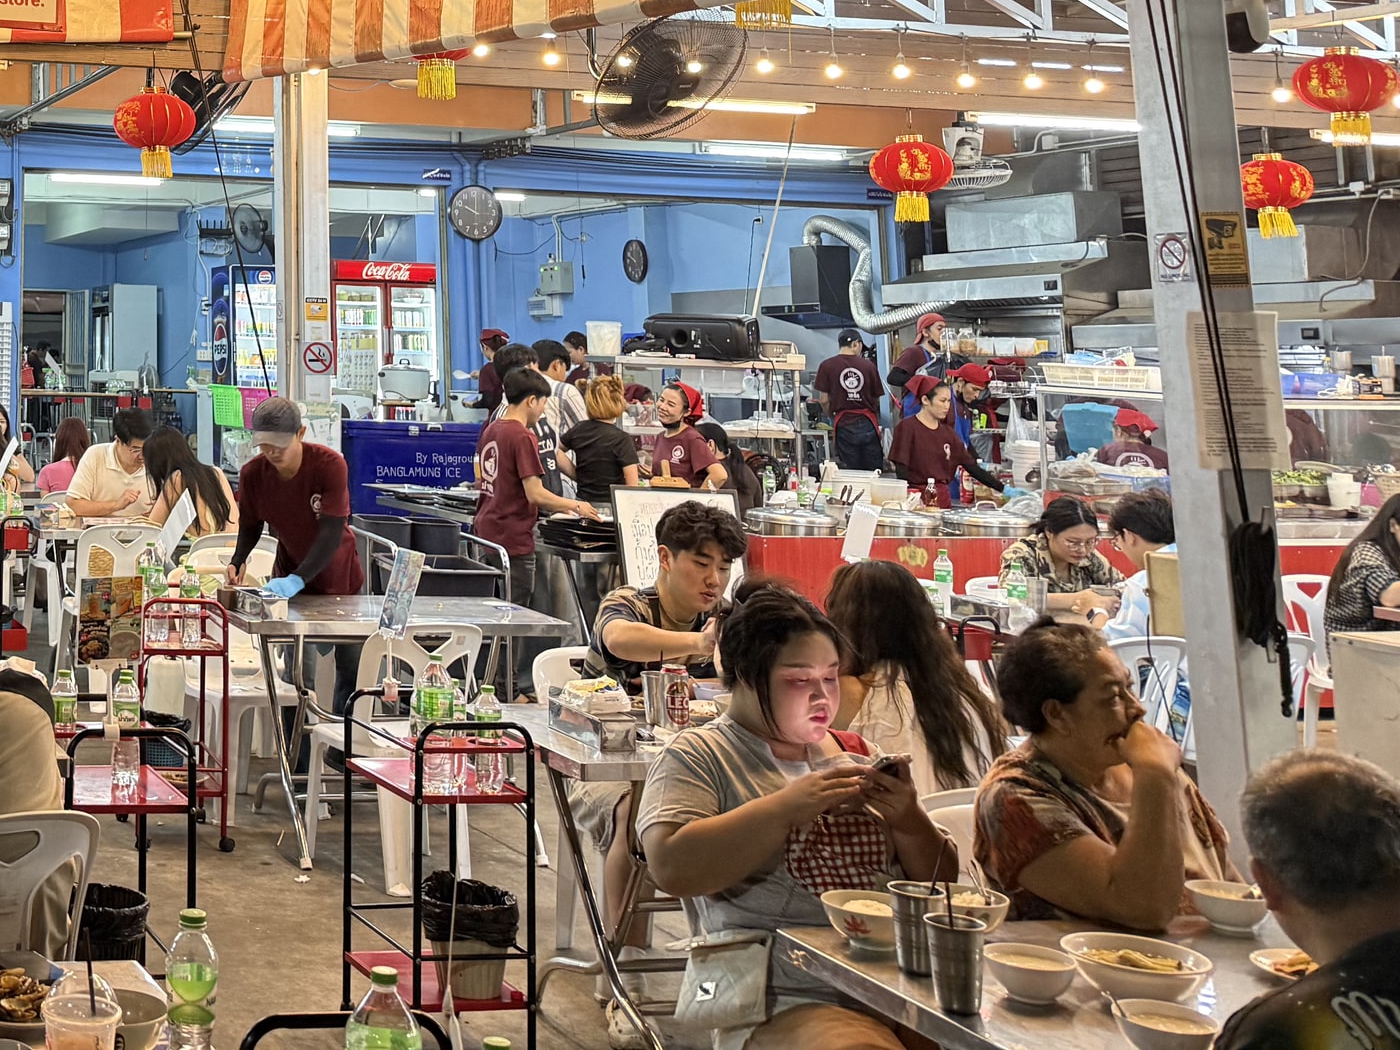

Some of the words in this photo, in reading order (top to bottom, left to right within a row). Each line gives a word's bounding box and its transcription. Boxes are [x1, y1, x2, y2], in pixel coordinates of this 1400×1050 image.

[415, 452, 428, 464] By
[432, 453, 474, 465] Rajagrou
[376, 465, 441, 478] BANGLAMUNG
[445, 467, 461, 478] ICE
